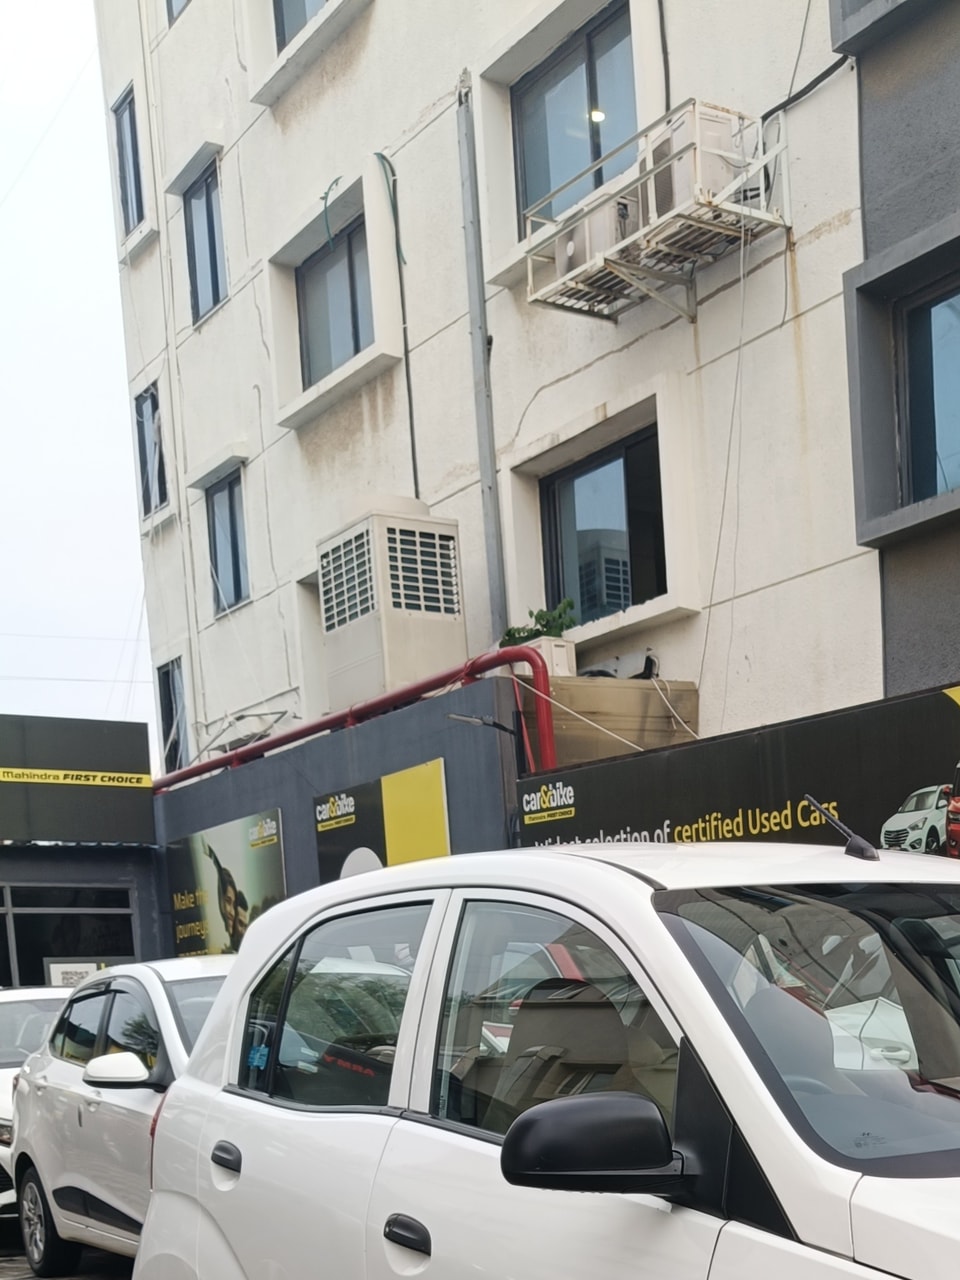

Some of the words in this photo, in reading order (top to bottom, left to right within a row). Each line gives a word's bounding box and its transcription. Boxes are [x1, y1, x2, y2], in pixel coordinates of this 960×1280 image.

[2, 770, 60, 781] Mahindra
[62, 773, 99, 782] FIRST
[100, 774, 144, 784] CHOICE
[316, 793, 355, 821] car&bike
[522, 781, 575, 812] car&bike
[674, 808, 744, 843] certified
[748, 799, 793, 835] Used
[797, 799, 839, 828] Cars
